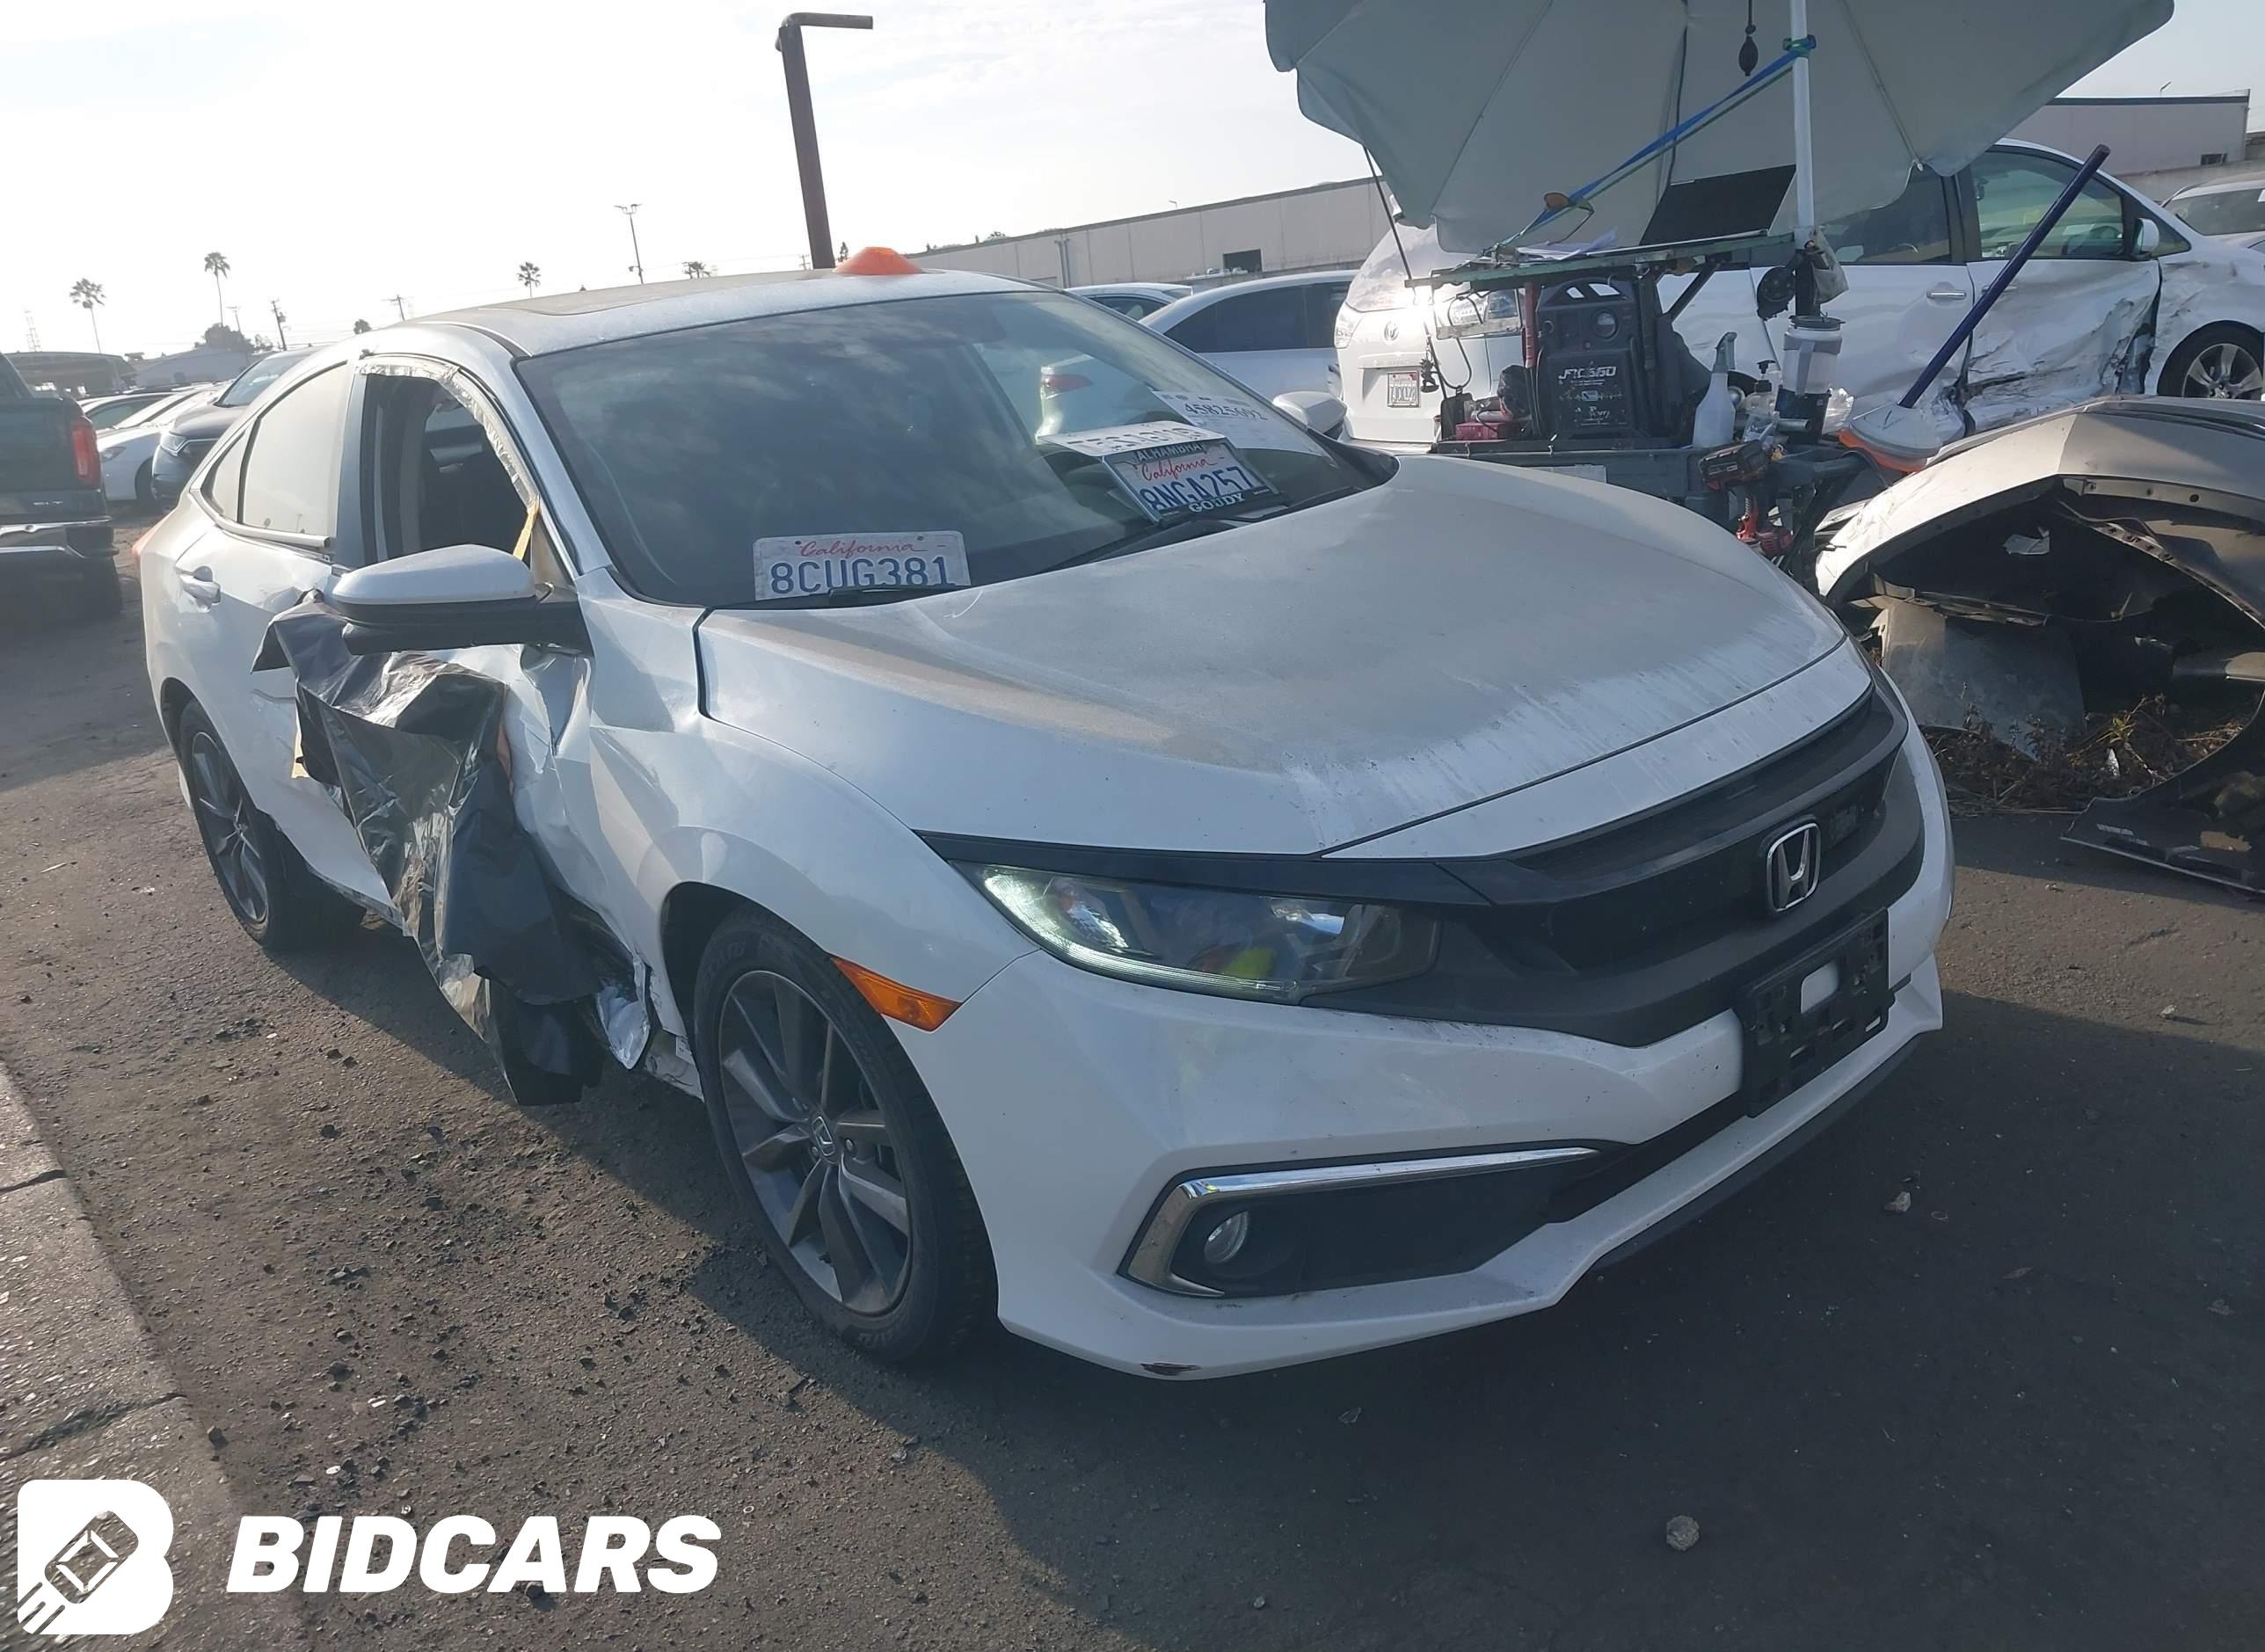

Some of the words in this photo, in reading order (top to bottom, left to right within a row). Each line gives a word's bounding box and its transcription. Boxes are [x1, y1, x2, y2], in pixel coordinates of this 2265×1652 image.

[1141, 456, 1218, 481] California
[1140, 466, 1253, 509] 8NGA257
[799, 540, 928, 558] California
[770, 556, 956, 594] 8CUG381
